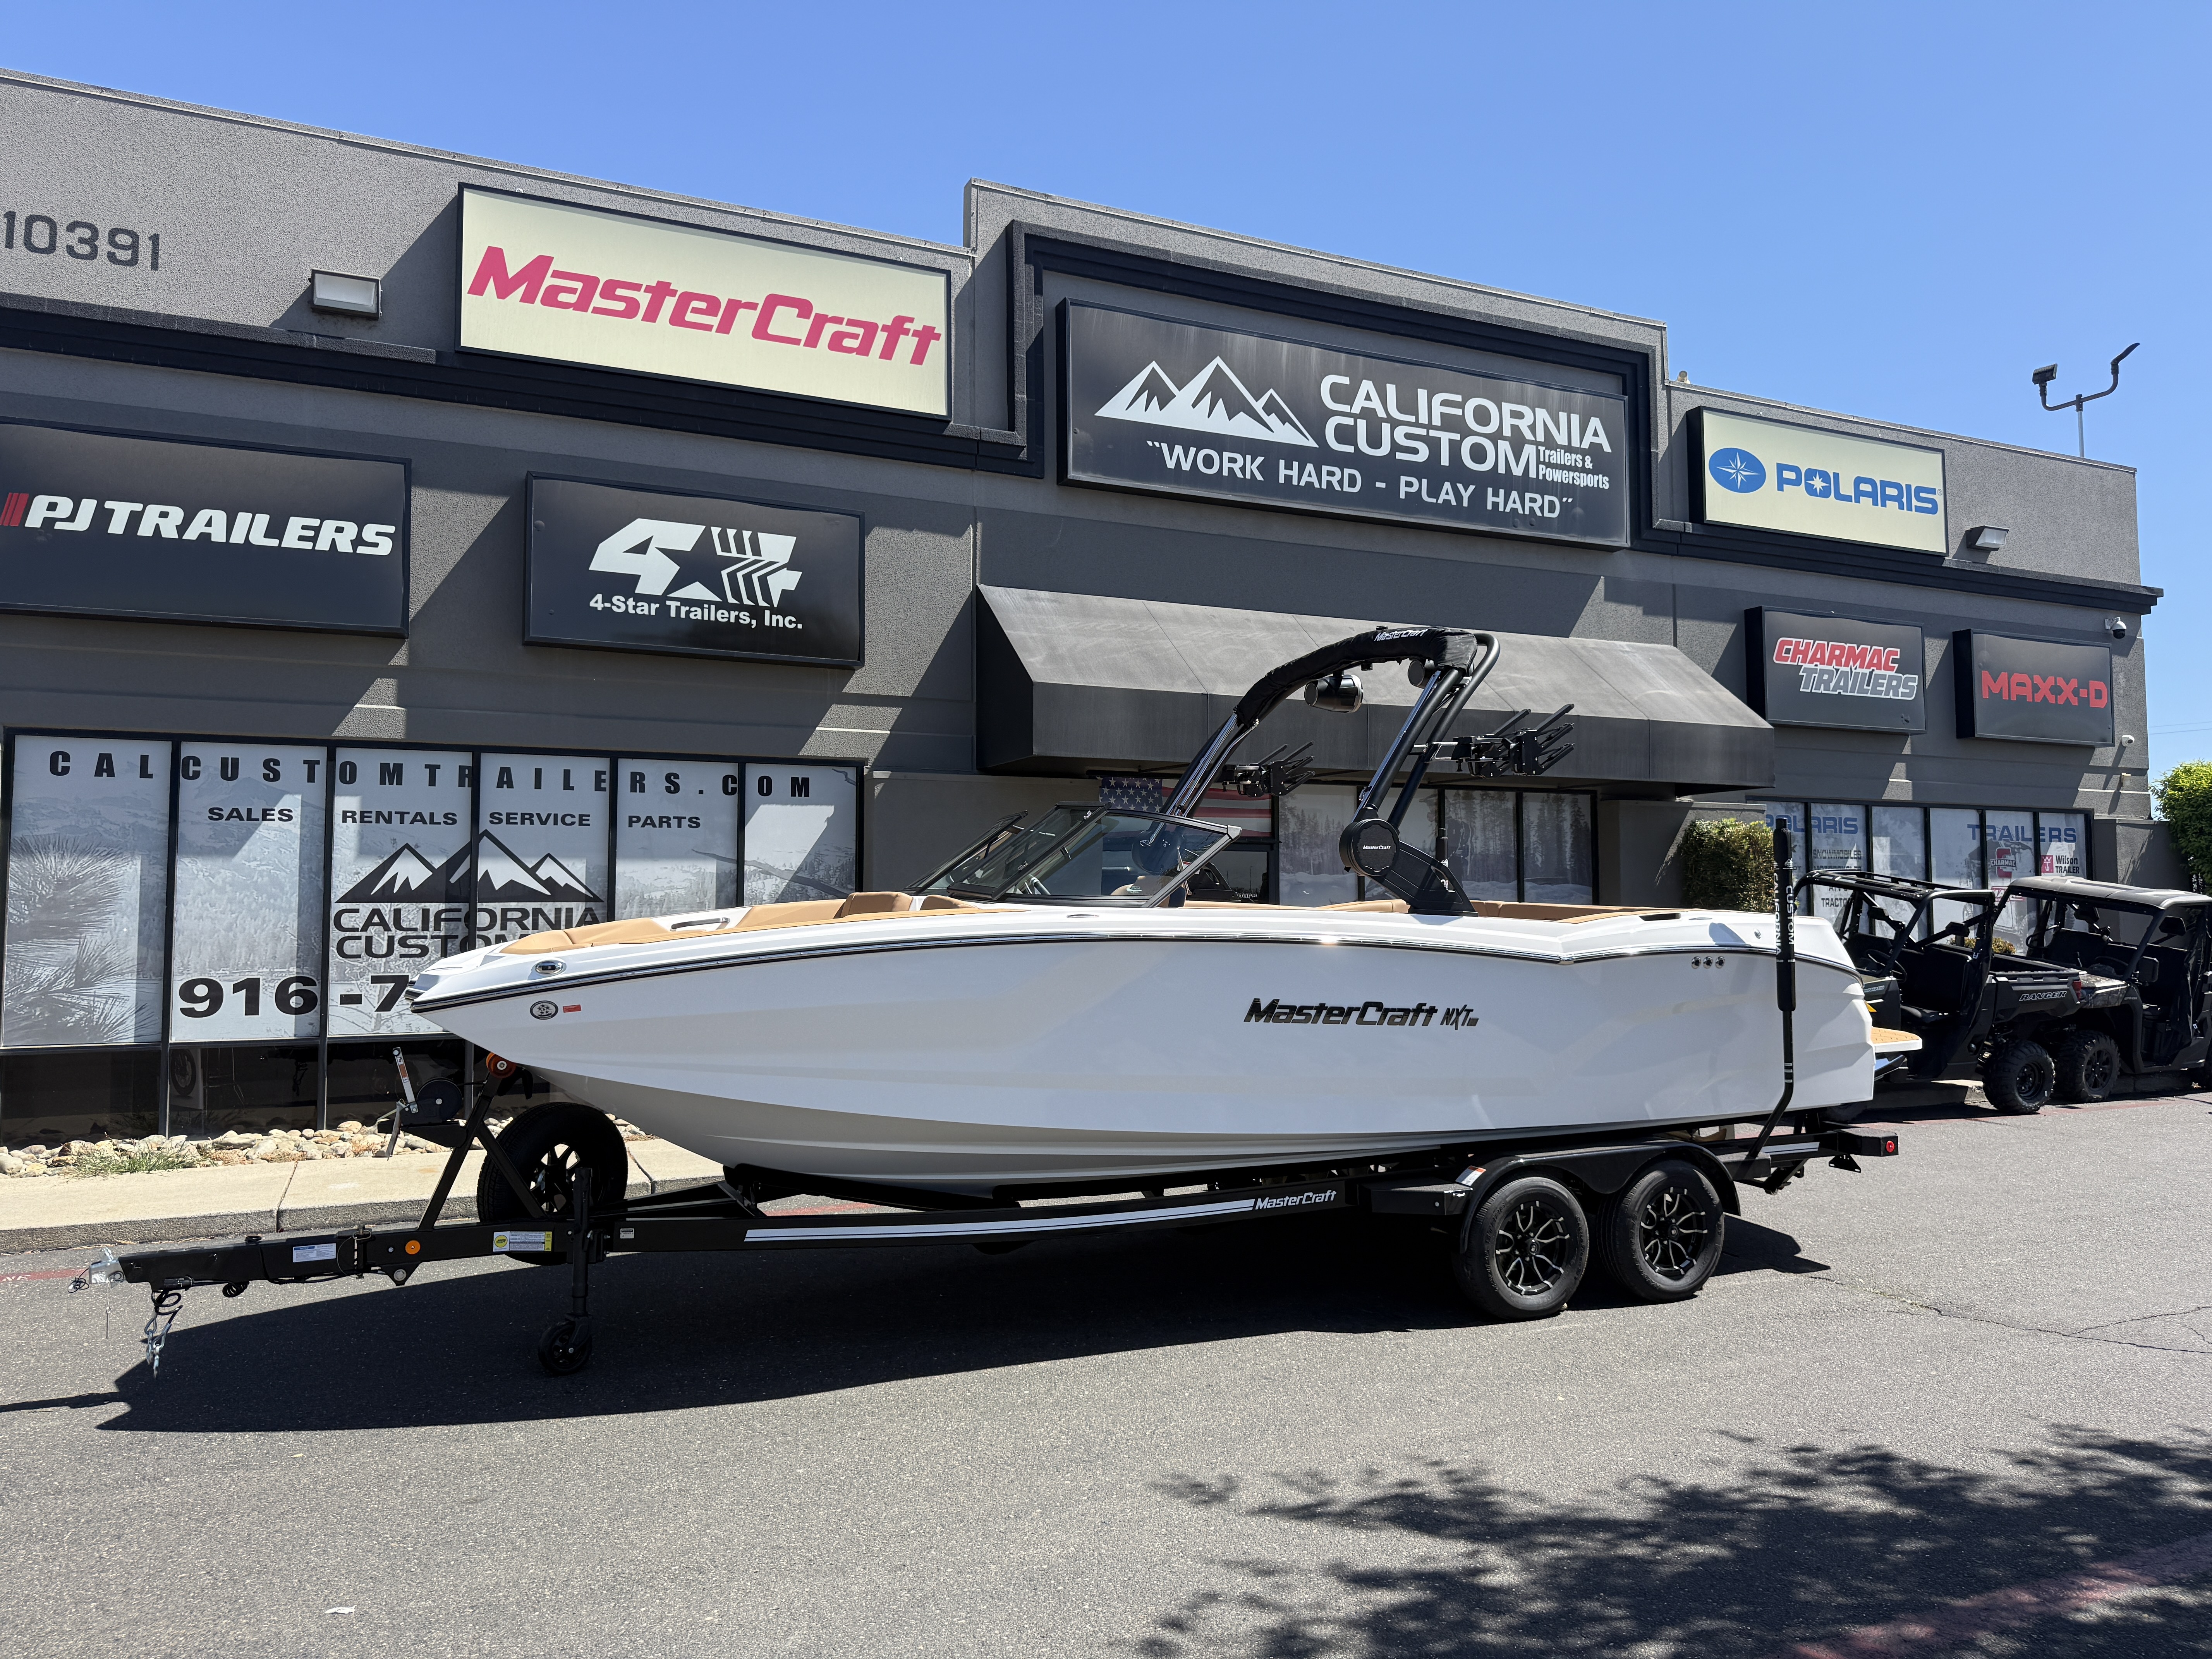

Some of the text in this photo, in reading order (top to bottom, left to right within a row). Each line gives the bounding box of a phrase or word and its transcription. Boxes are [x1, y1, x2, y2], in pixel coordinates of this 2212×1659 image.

[3, 211, 160, 271] 10391
[467, 246, 941, 366] MasterCraft
[1321, 374, 1612, 453] CALIFORNIA
[1325, 416, 1537, 478] CUSTOM
[1539, 446, 1593, 469] Trailers &
[1279, 459, 1362, 493] HARD
[1400, 475, 1475, 507] PLAY
[1539, 465, 1609, 489] Powersports
[1776, 462, 1939, 515] POLARIS
[24, 495, 396, 556] PJ TRAILERS
[589, 593, 803, 629] 4-Star Trailers, Inc.
[1774, 638, 1900, 673] CHARMAC
[1800, 665, 1918, 700] TRAILERS
[1982, 670, 2107, 708] MAXX-D
[208, 807, 701, 829] SALES RENTALS SERVICE PARTS
[1967, 824, 2076, 843] TRAILERS
[1813, 849, 1862, 859] SNOWMOBILES
[2055, 855, 2078, 865] Wilson
[2055, 866, 2080, 874] TRAILER
[333, 907, 601, 932] CALIFORNIA
[1786, 885, 1795, 945] CUSTOM
[336, 934, 526, 959] CUST
[2019, 991, 2067, 1001] RANGER
[1243, 998, 1438, 1026] MasterCraft
[1255, 1190, 1337, 1210] MasterCraft
